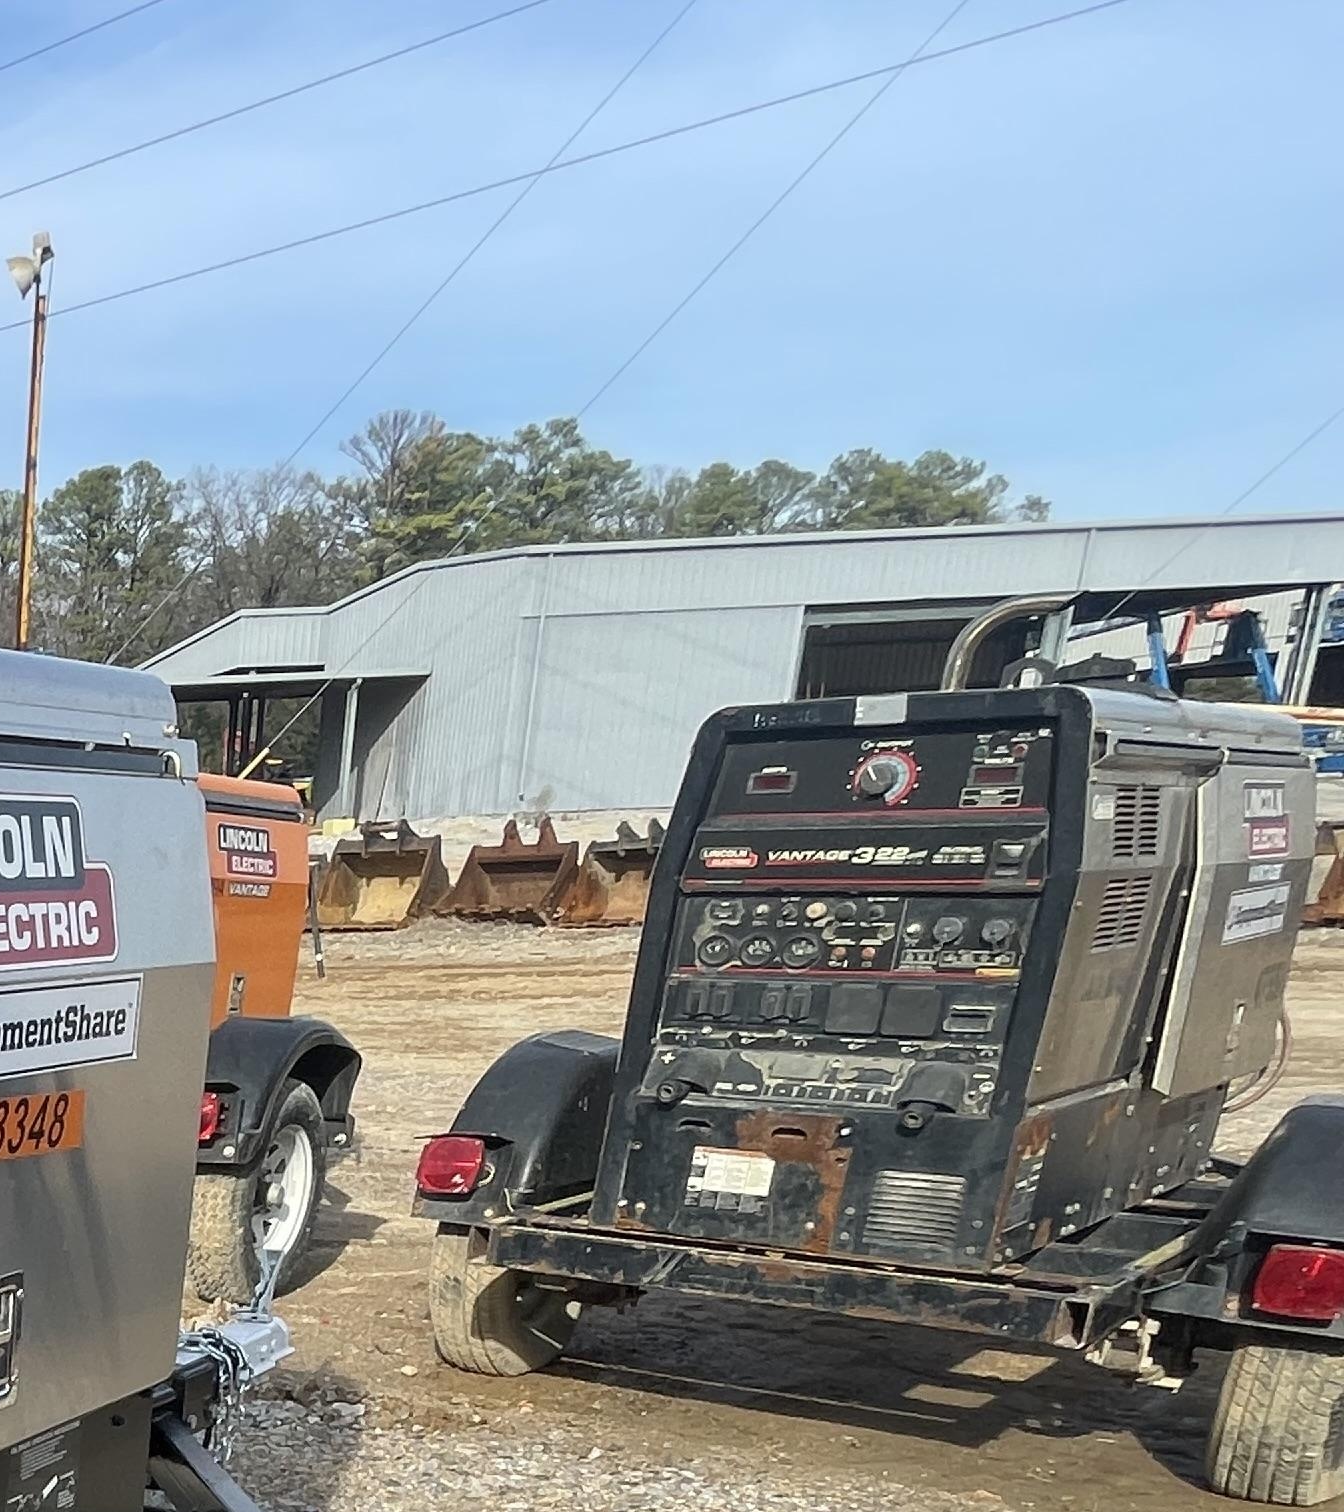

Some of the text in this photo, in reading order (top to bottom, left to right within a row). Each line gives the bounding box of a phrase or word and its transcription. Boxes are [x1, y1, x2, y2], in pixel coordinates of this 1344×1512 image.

[219, 826, 268, 853] LINCOLN
[703, 849, 749, 858] LINCOLN
[767, 849, 853, 862] VANTAGE
[232, 855, 274, 875] ELECTRIC
[229, 883, 270, 897] VANTAGE
